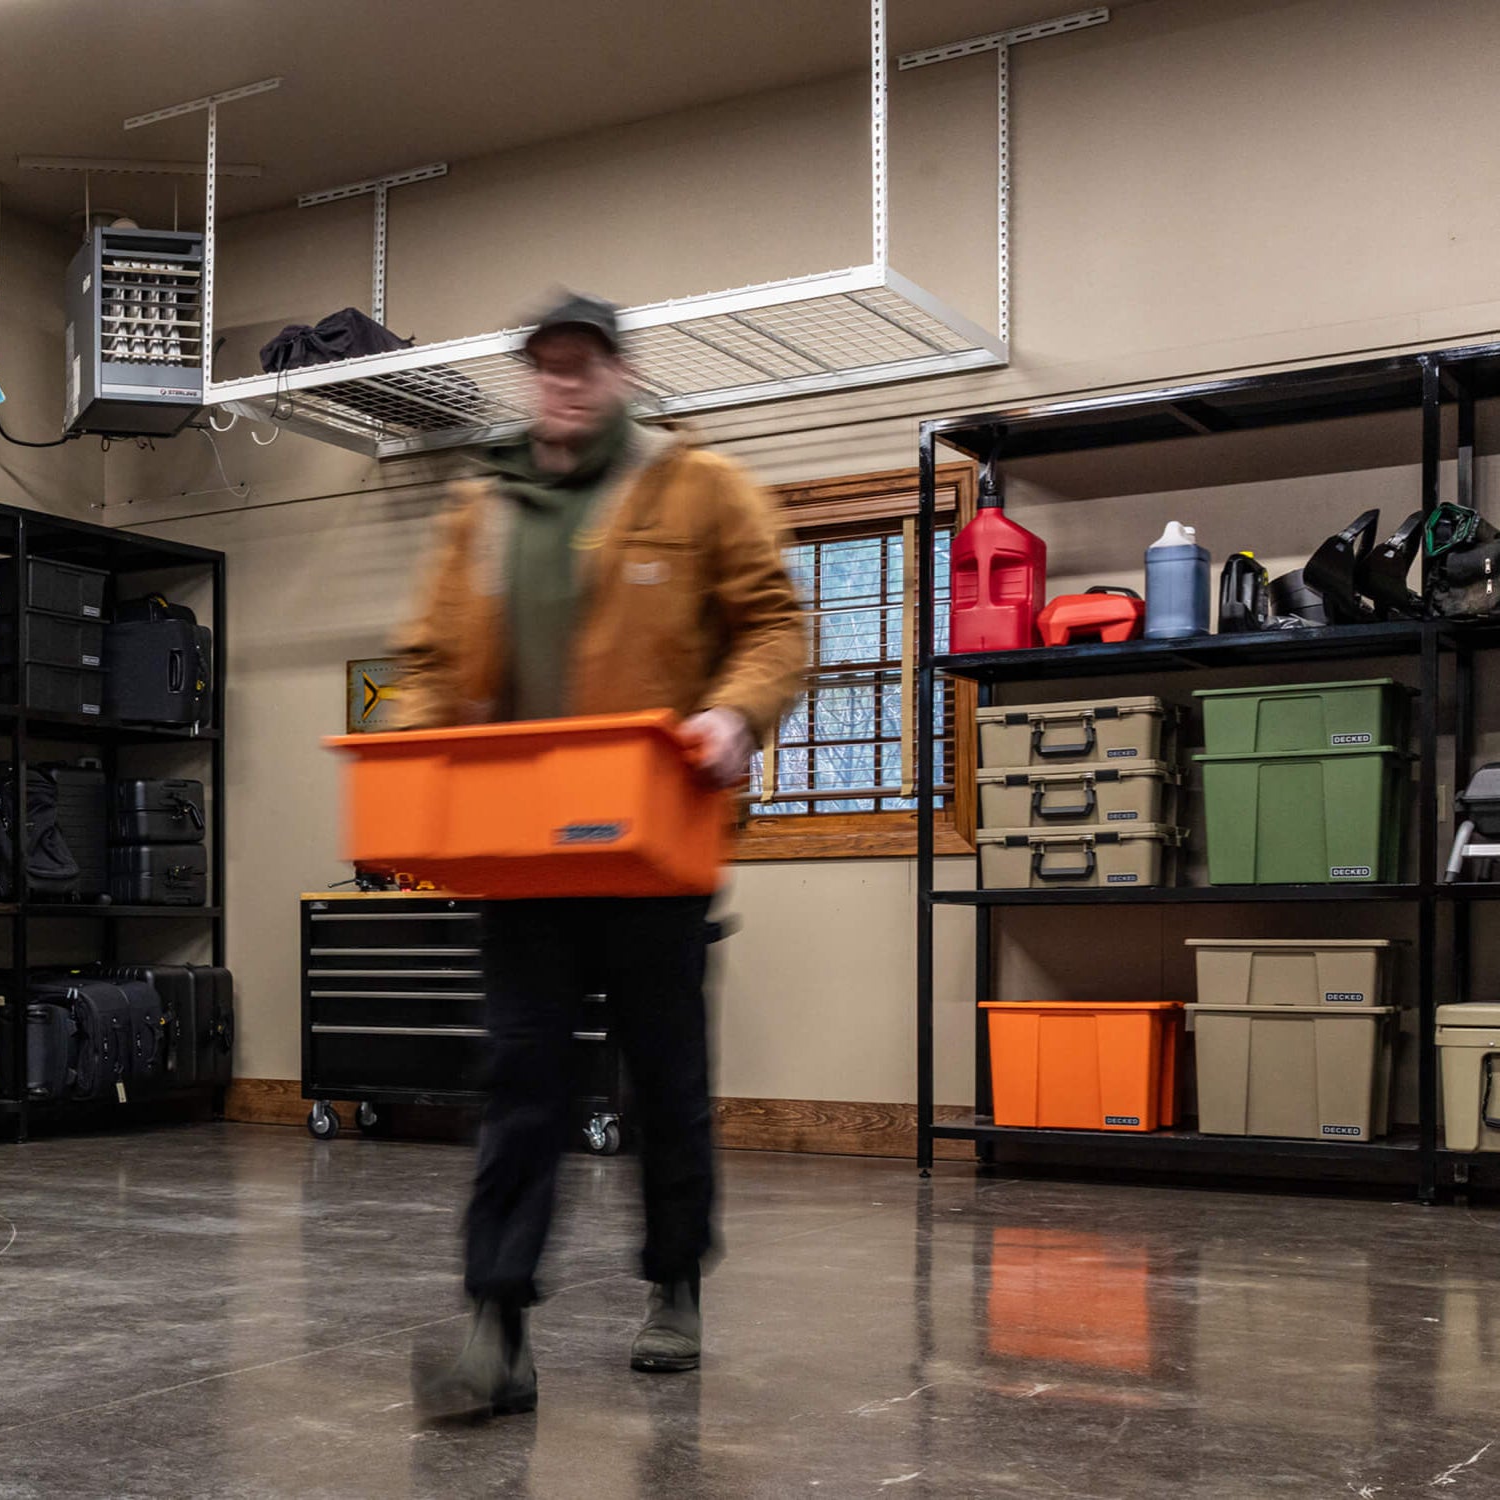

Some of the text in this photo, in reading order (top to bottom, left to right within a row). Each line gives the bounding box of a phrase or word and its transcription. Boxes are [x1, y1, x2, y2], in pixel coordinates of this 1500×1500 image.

[1334, 735, 1369, 743] DECKED
[1333, 868, 1368, 876] DECKED
[1324, 1126, 1359, 1135] DECKED
